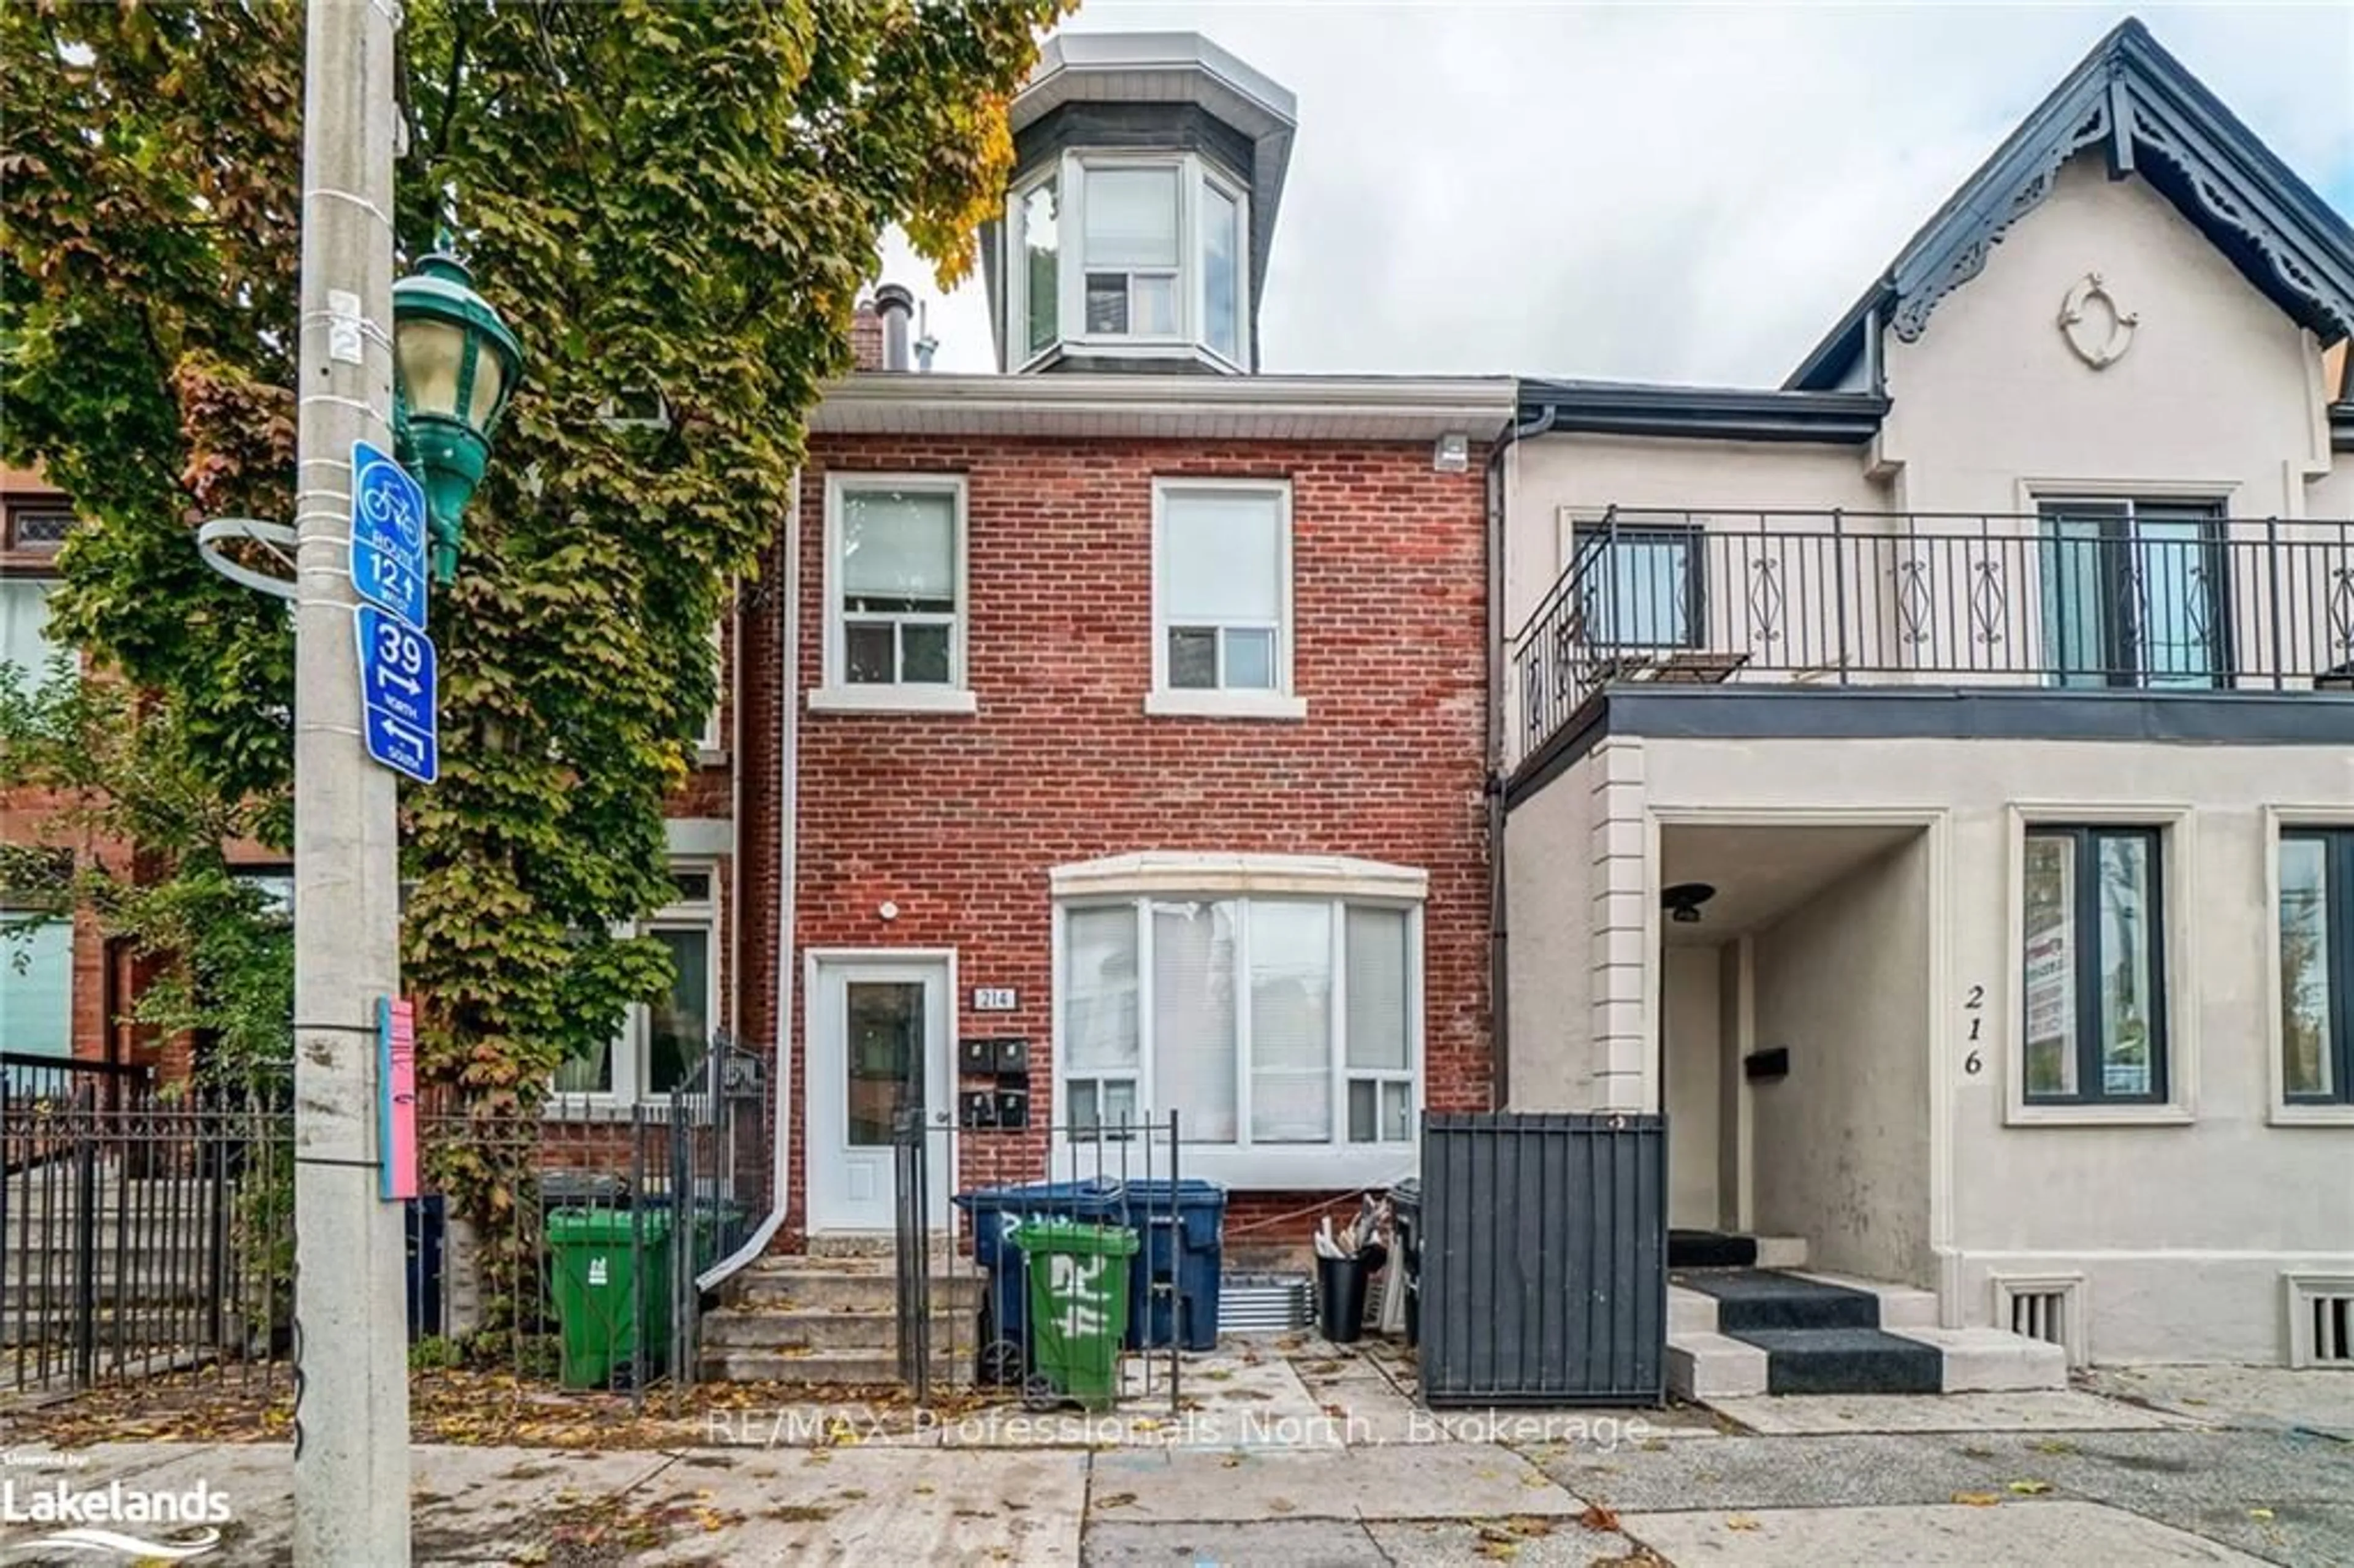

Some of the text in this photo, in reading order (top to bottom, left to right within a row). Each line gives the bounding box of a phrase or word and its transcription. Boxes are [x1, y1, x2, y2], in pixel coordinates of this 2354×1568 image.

[370, 553, 401, 593] 12
[378, 623, 422, 674] 39
[981, 991, 1008, 1007] 214
[1964, 984, 1984, 1075] 216
